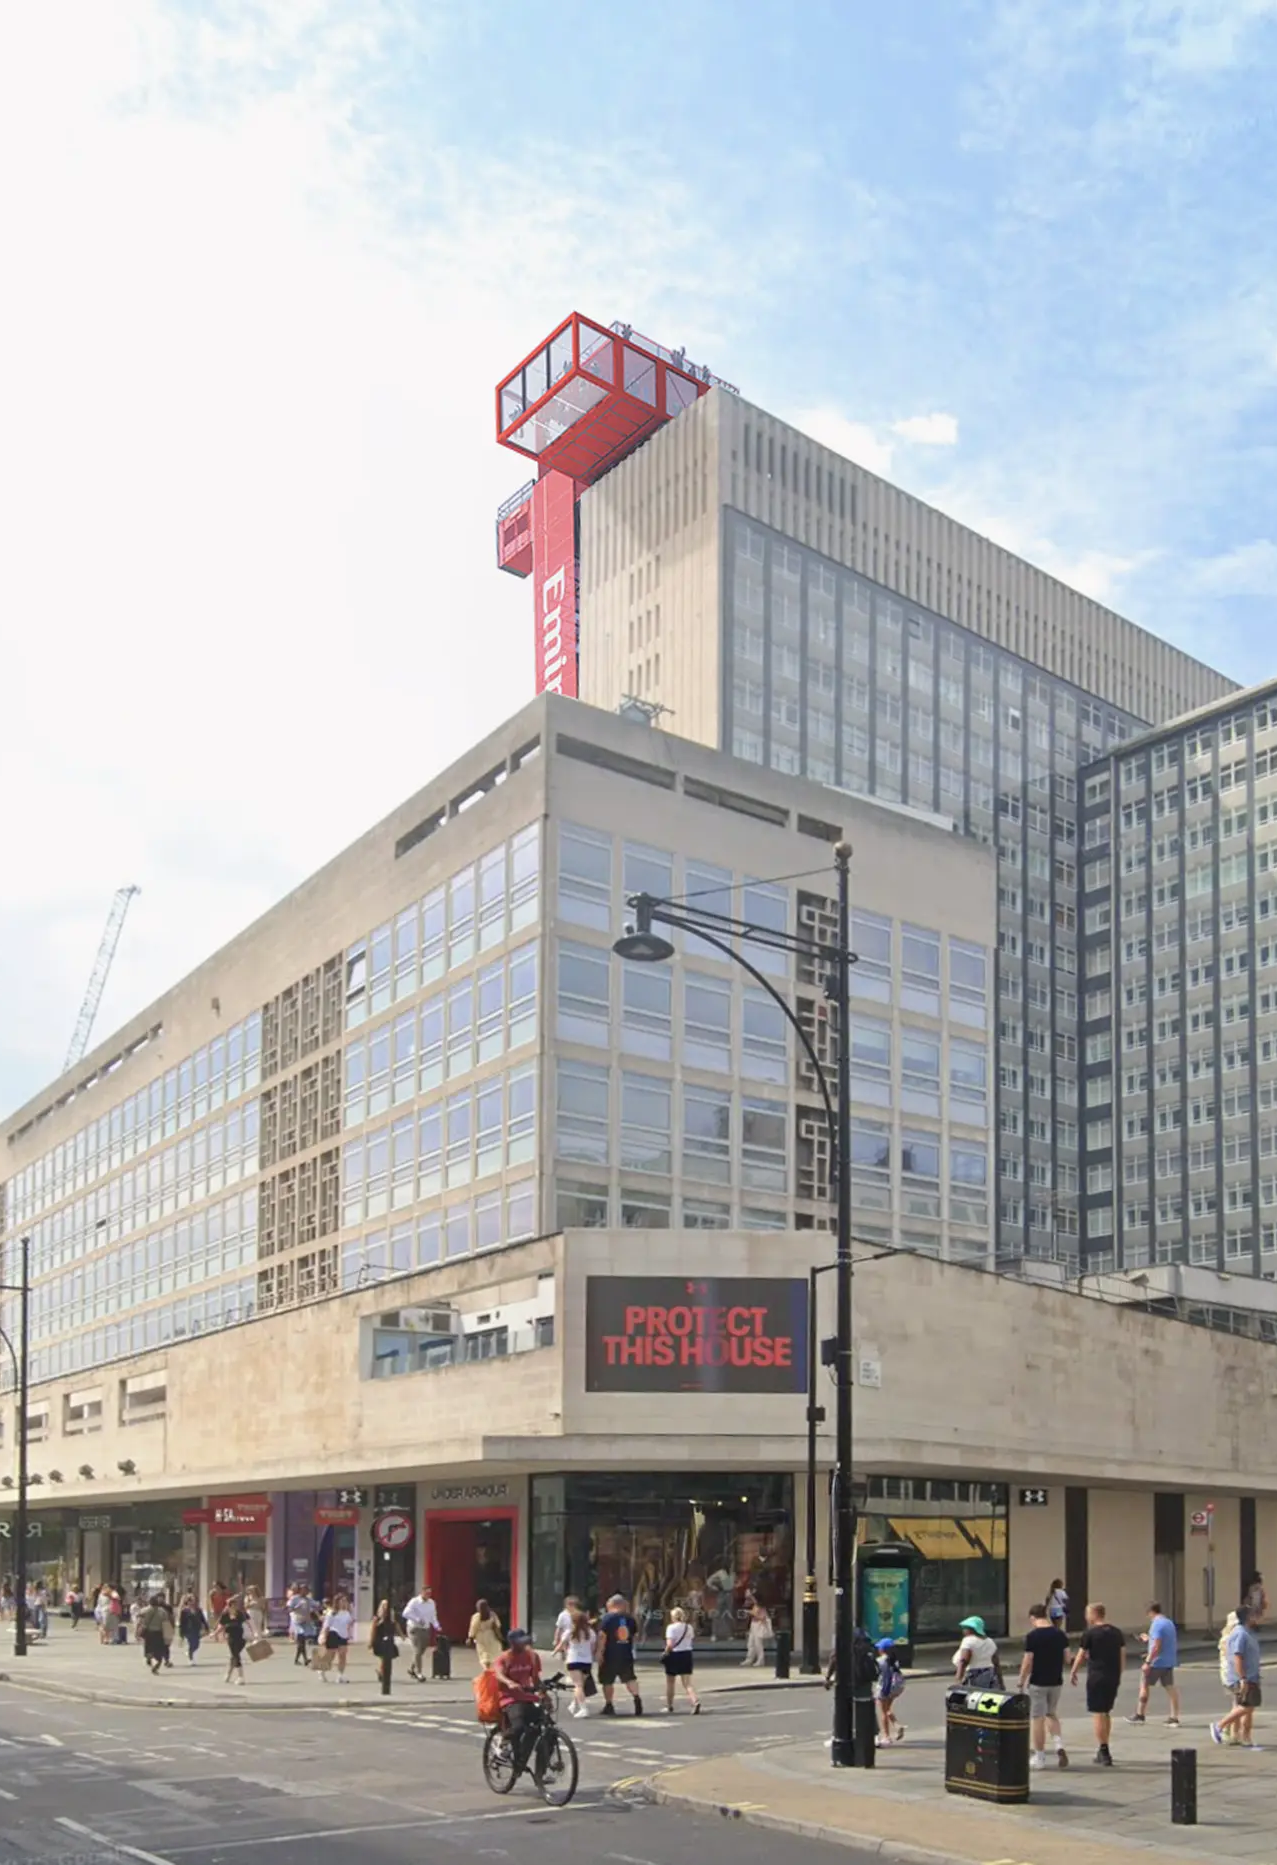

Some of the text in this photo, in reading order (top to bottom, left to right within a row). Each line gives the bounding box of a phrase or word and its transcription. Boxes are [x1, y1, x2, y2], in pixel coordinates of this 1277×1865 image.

[624, 1305, 768, 1337] PROTECT
[602, 1335, 792, 1368] THIS HOUSE
